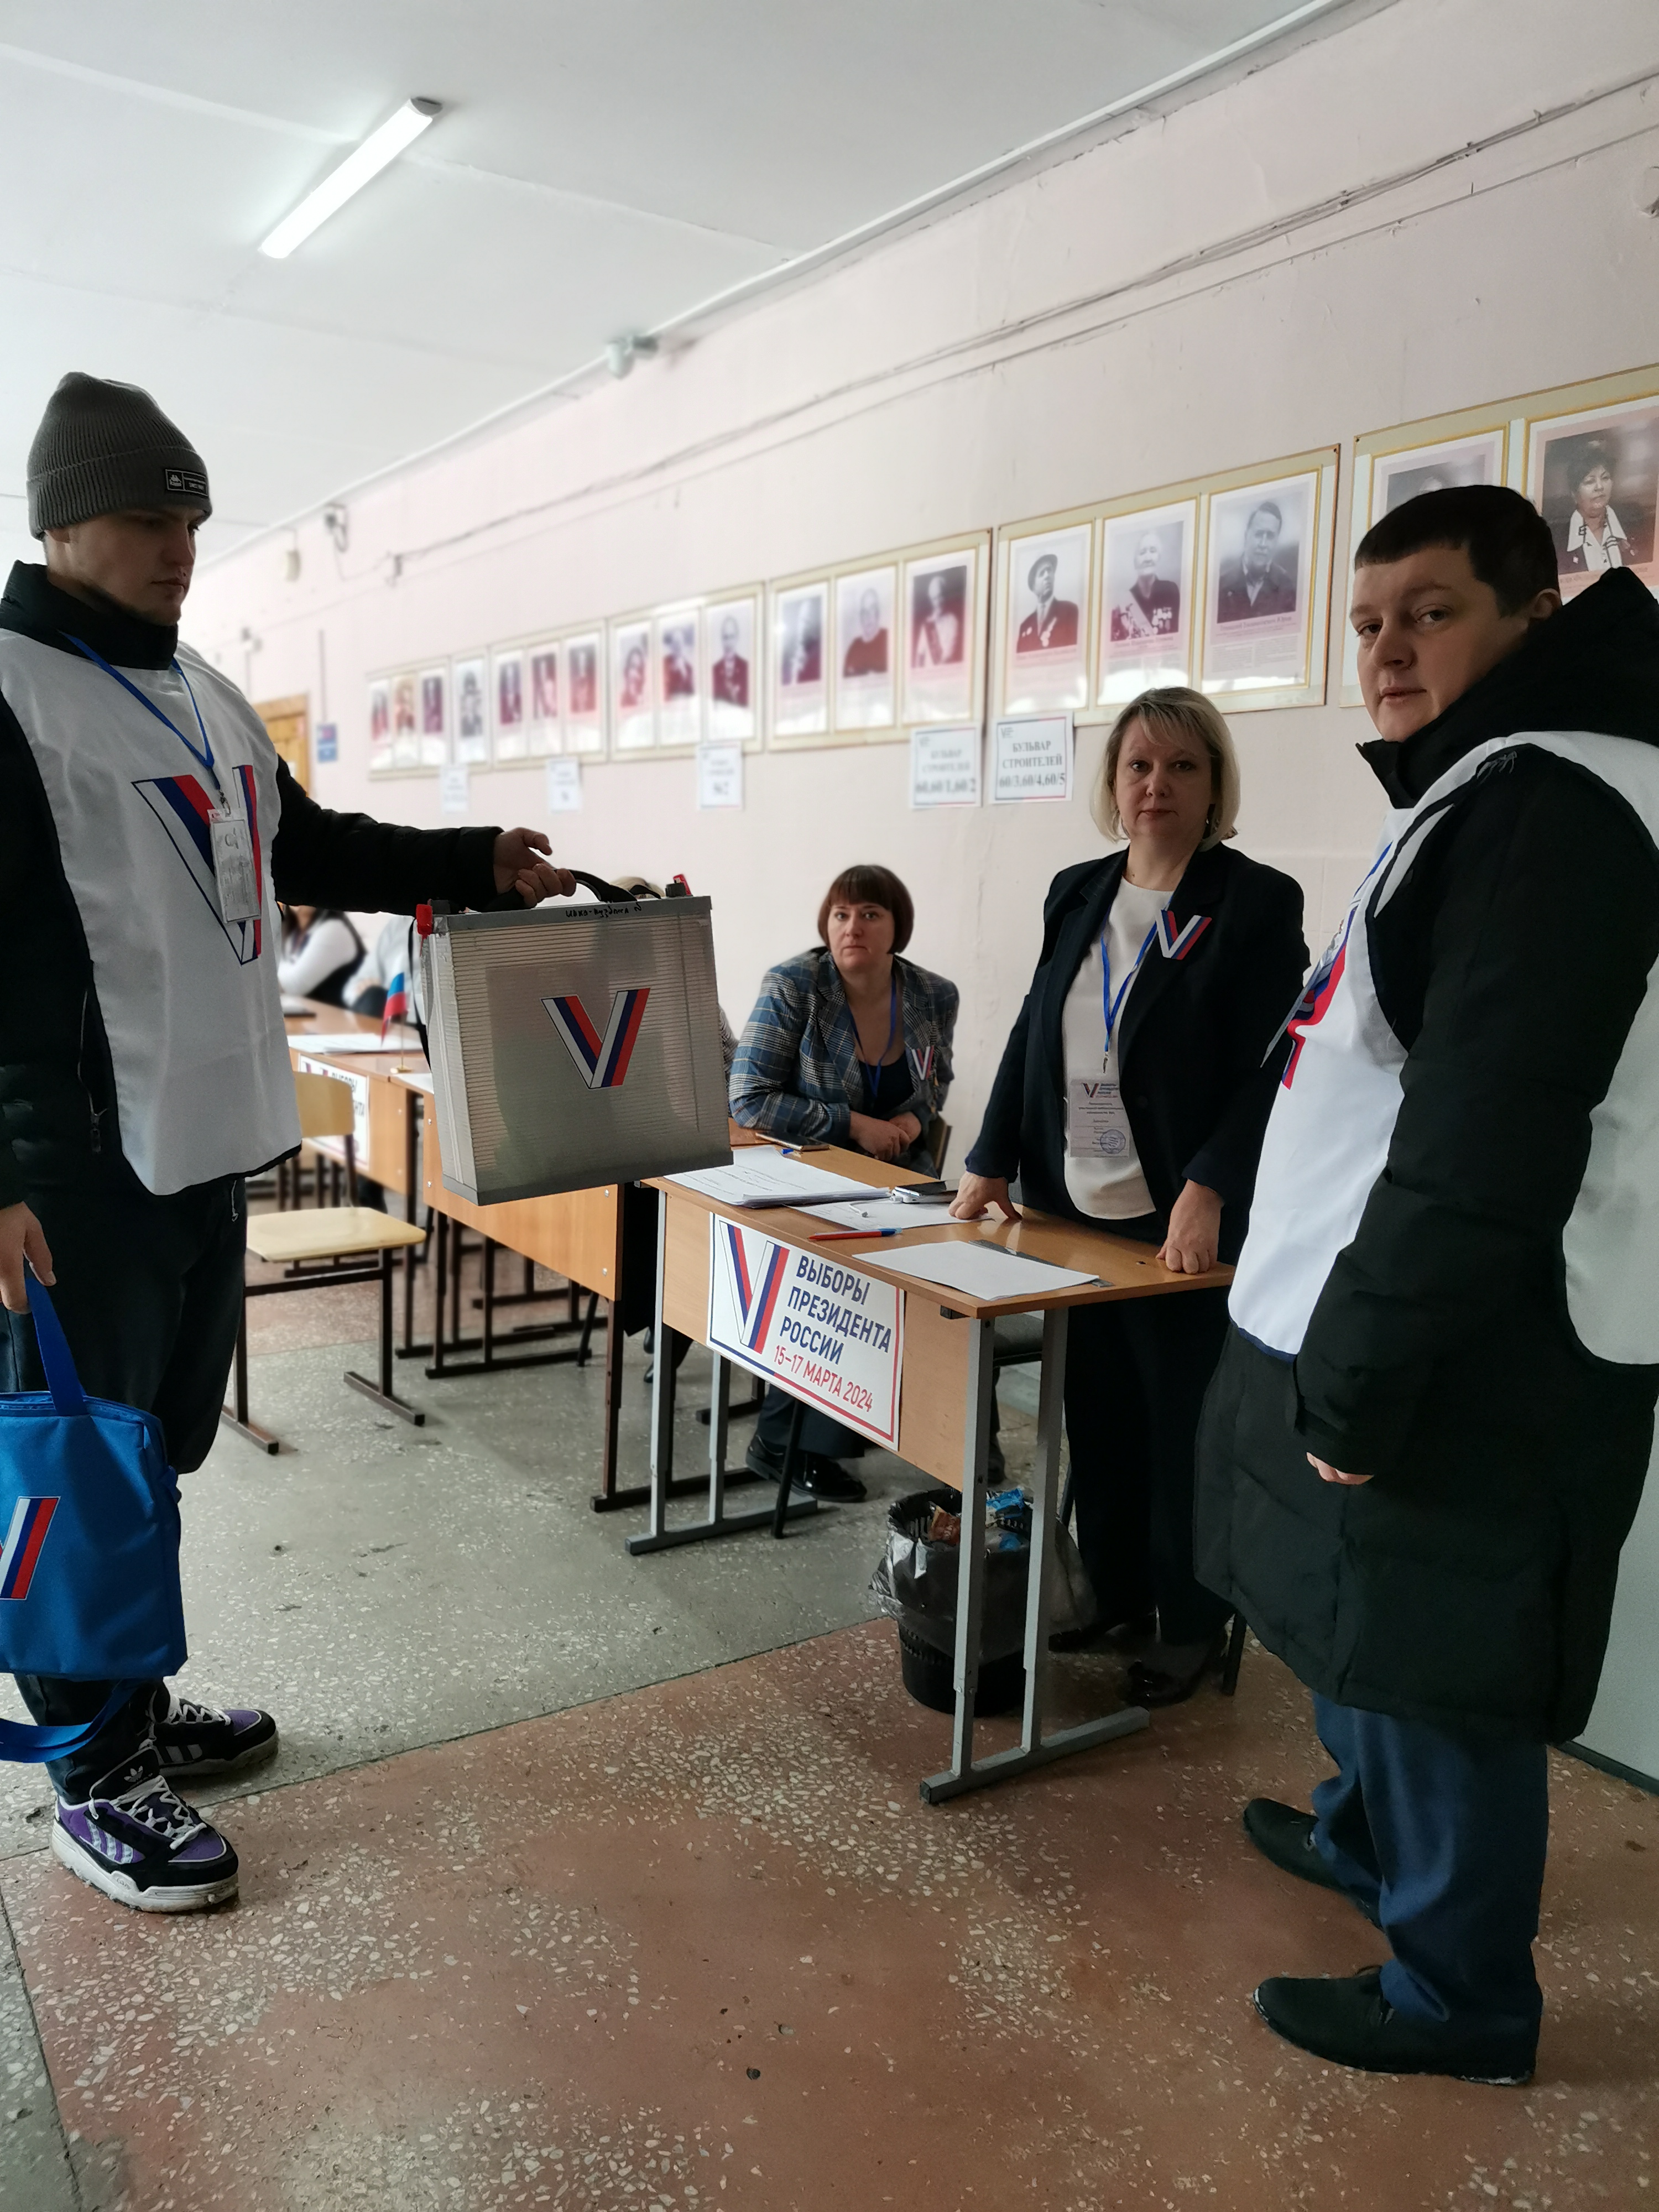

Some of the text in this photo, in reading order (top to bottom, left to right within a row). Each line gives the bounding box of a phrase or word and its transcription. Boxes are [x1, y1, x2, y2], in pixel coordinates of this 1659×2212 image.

[1003, 754, 1062, 769] СТРОИТЕЛЕЙ
[1013, 741, 1051, 753] БУЛЬВАР
[796, 1255, 870, 1306] ВЫБОРЫ
[780, 1316, 844, 1365] РОССИИ
[787, 1286, 891, 1353] ПРЕЗИДЕНТА
[802, 1360, 843, 1397] МАРТА
[843, 1381, 873, 1412] 2024
